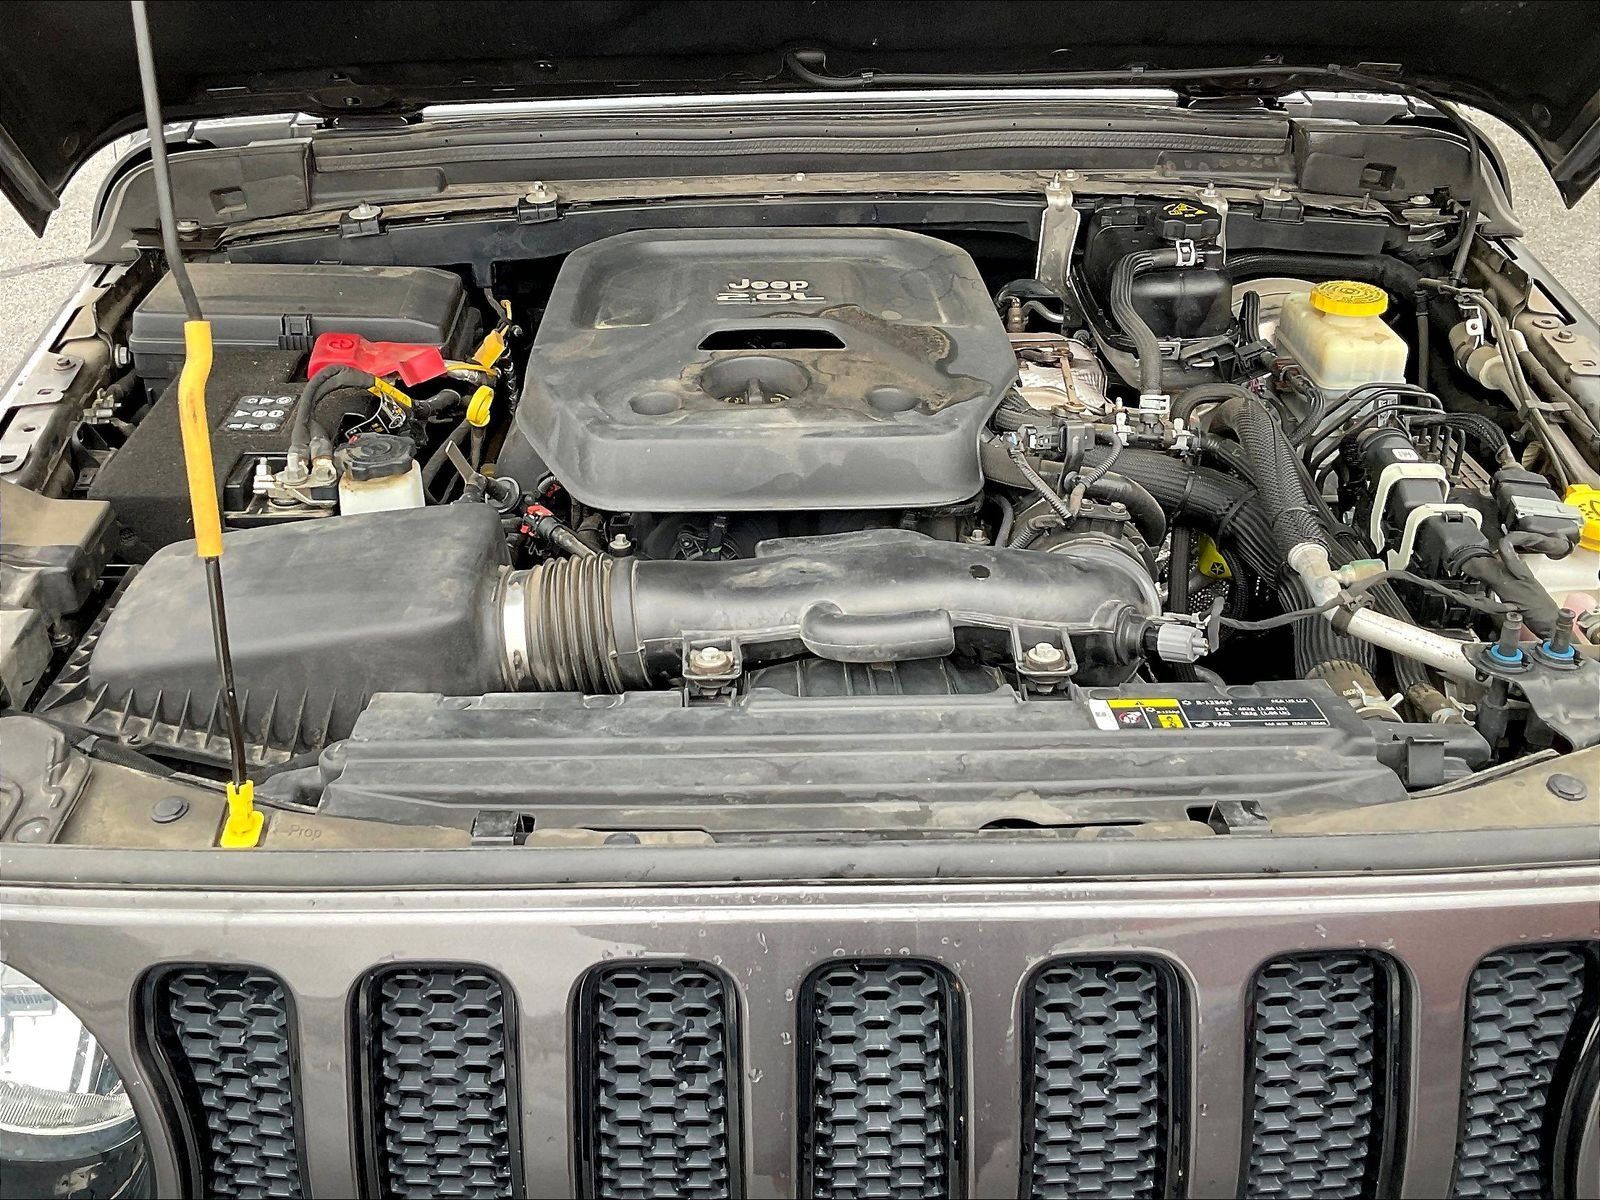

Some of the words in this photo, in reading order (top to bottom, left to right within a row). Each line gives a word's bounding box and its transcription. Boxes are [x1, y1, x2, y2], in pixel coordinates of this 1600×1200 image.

[728, 278, 809, 291] Jeep
[716, 292, 825, 304] 2.0L
[287, 824, 322, 841] Prop
